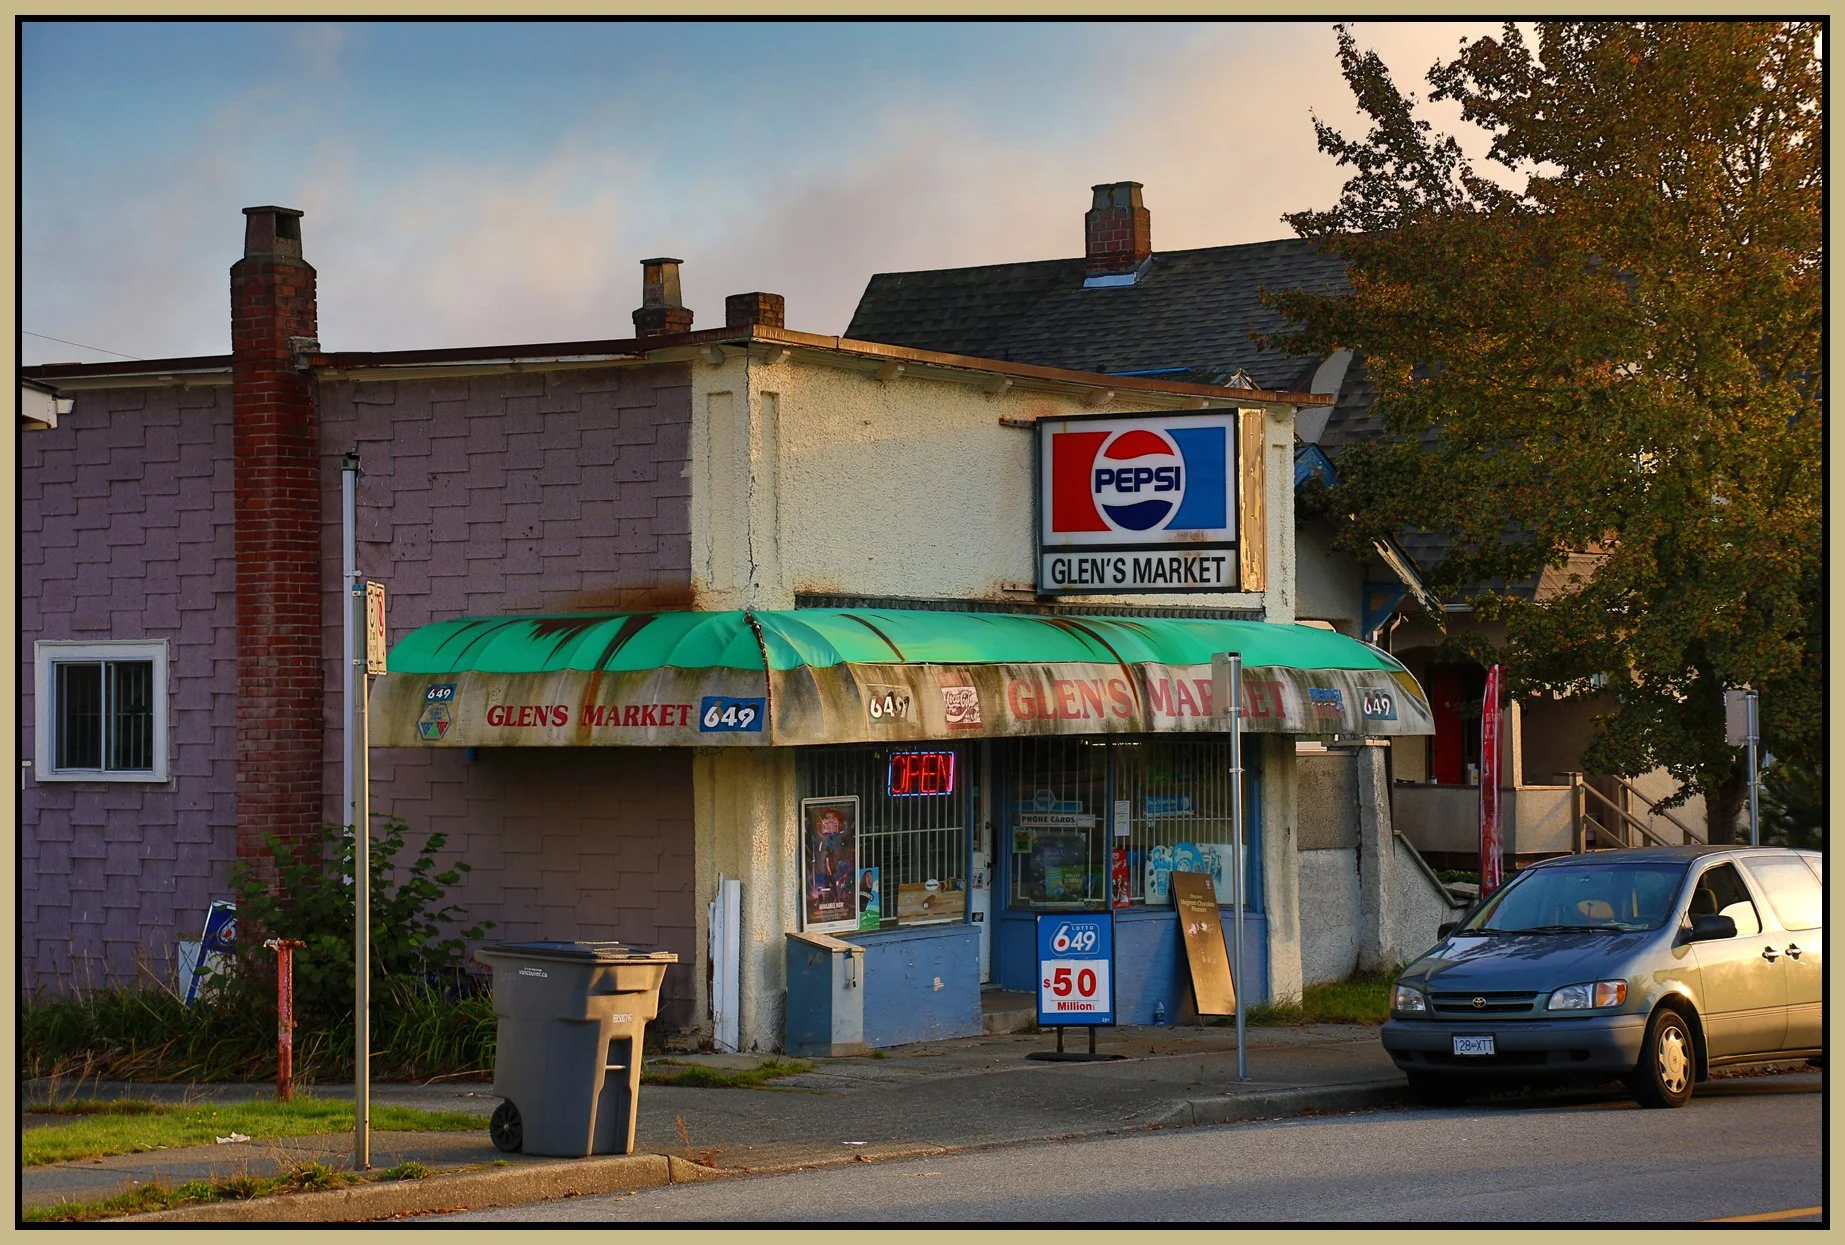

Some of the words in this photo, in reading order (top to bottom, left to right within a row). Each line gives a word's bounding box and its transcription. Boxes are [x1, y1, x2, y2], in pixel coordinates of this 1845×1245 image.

[1094, 466, 1181, 494] PEPSI
[1051, 557, 1127, 585] GLEN'S
[1132, 556, 1227, 584] MARKET
[427, 688, 452, 699] 649
[1007, 678, 1133, 720] GLEN'S
[1145, 678, 1287, 718] MARET
[1363, 693, 1392, 716] 649
[486, 705, 569, 728] GLEN'S
[583, 704, 693, 727] MARKET
[703, 706, 756, 729] 649
[891, 755, 953, 794] OPEN
[1021, 815, 1048, 823] PHONE
[1050, 815, 1076, 823] CARDS
[1053, 925, 1096, 952] 649
[1057, 1001, 1092, 1011] Million
